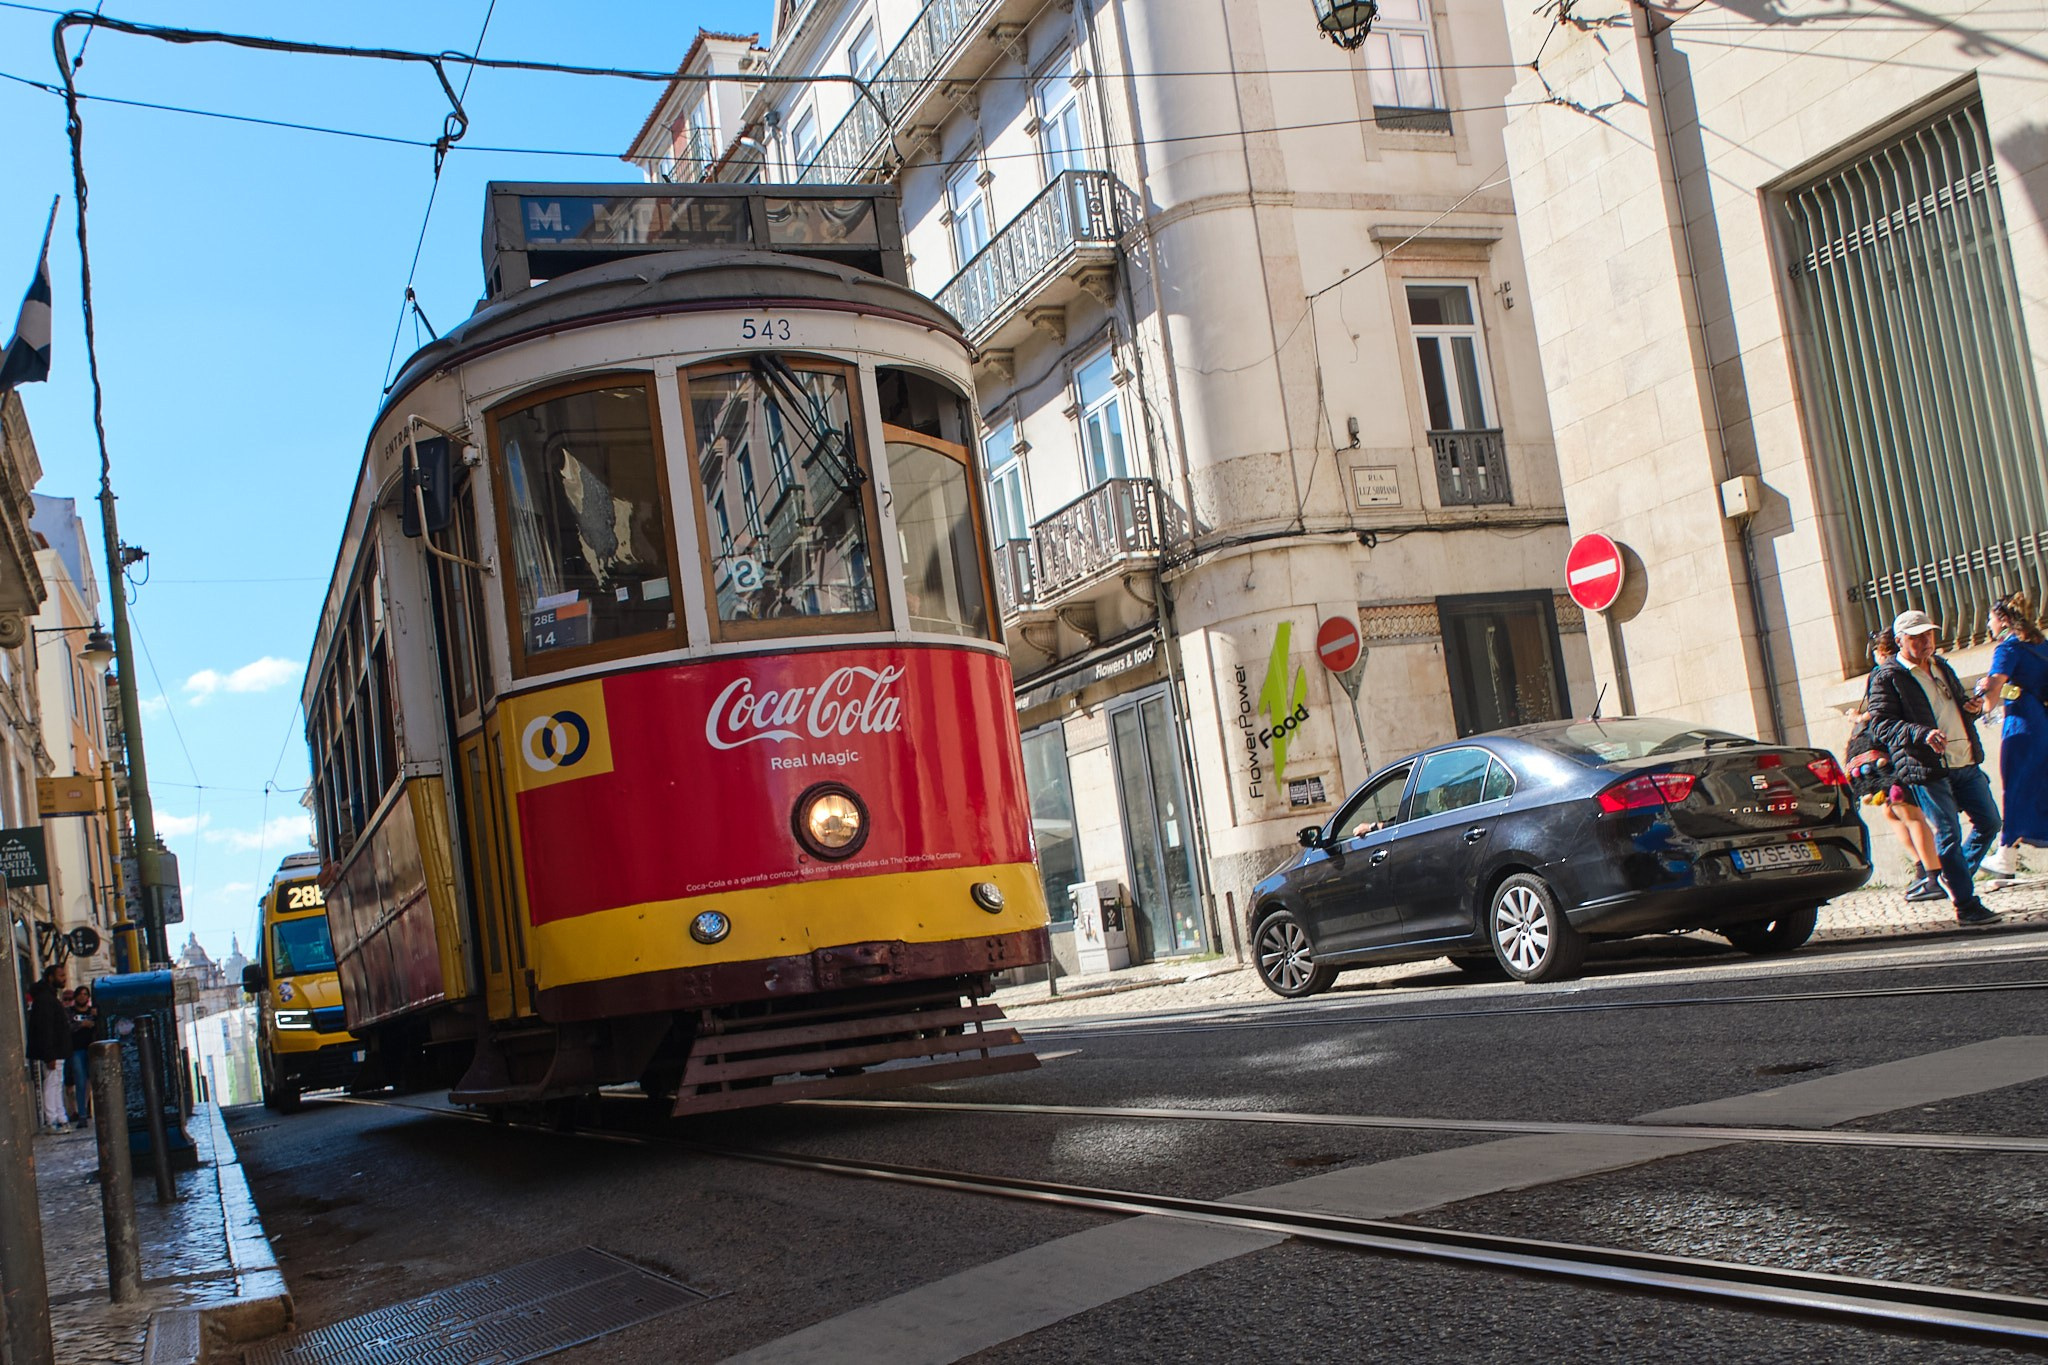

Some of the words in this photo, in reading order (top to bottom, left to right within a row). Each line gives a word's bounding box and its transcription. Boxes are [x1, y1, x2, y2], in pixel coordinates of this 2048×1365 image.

[528, 202, 571, 231] M.
[594, 202, 734, 232] MONIZ
[742, 318, 791, 341] 543
[534, 613, 555, 627] 28E
[535, 631, 556, 648] 14
[1126, 653, 1133, 668] &
[705, 665, 905, 750] Coca-Cola
[1258, 703, 1310, 749] Food
[771, 754, 808, 770] Real
[812, 749, 859, 768] Magic
[1729, 802, 1799, 814] TOLEDO
[686, 880, 726, 892] Coca-Cola
[740, 873, 768, 885] garrafa
[769, 869, 799, 880] contour
[815, 863, 841, 873] marcas
[842, 859, 879, 871] registadas
[880, 857, 889, 866] da
[890, 857, 903, 865] The
[904, 853, 935, 863] Coca-Cola
